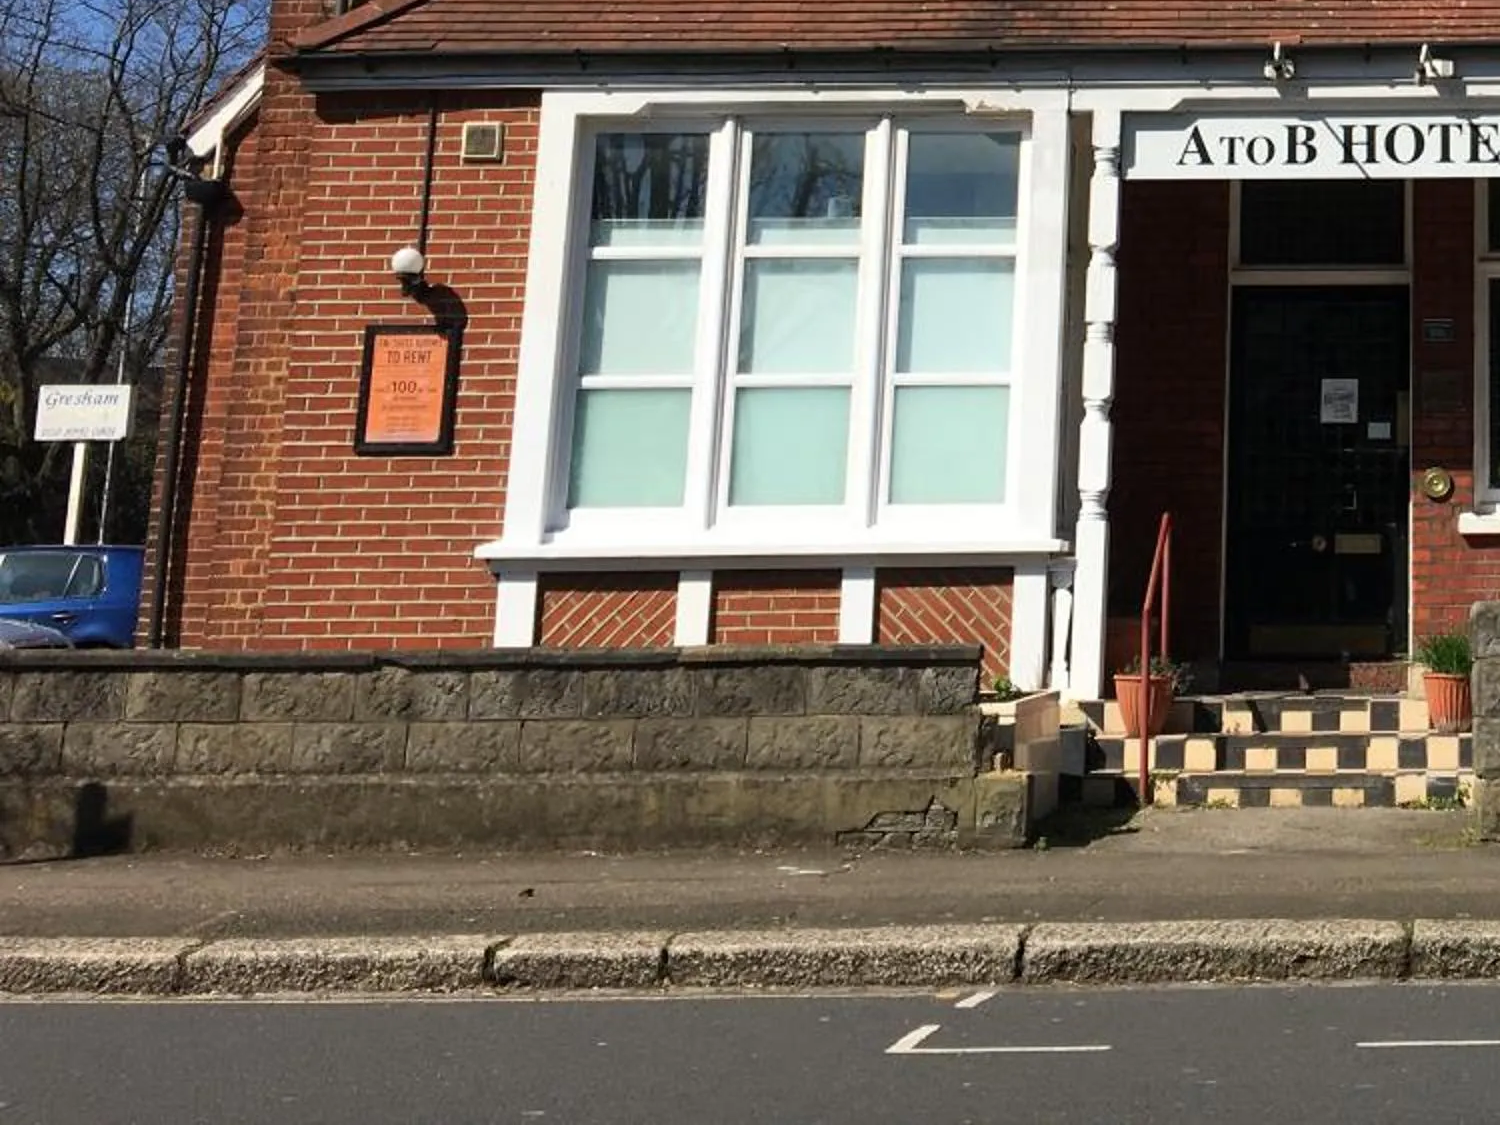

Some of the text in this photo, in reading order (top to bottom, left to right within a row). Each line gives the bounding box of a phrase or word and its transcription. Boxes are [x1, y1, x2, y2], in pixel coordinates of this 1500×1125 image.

[1177, 124, 1215, 165] A
[1219, 136, 1276, 165] TO
[1284, 124, 1318, 165] B
[45, 387, 120, 410] Gresham
